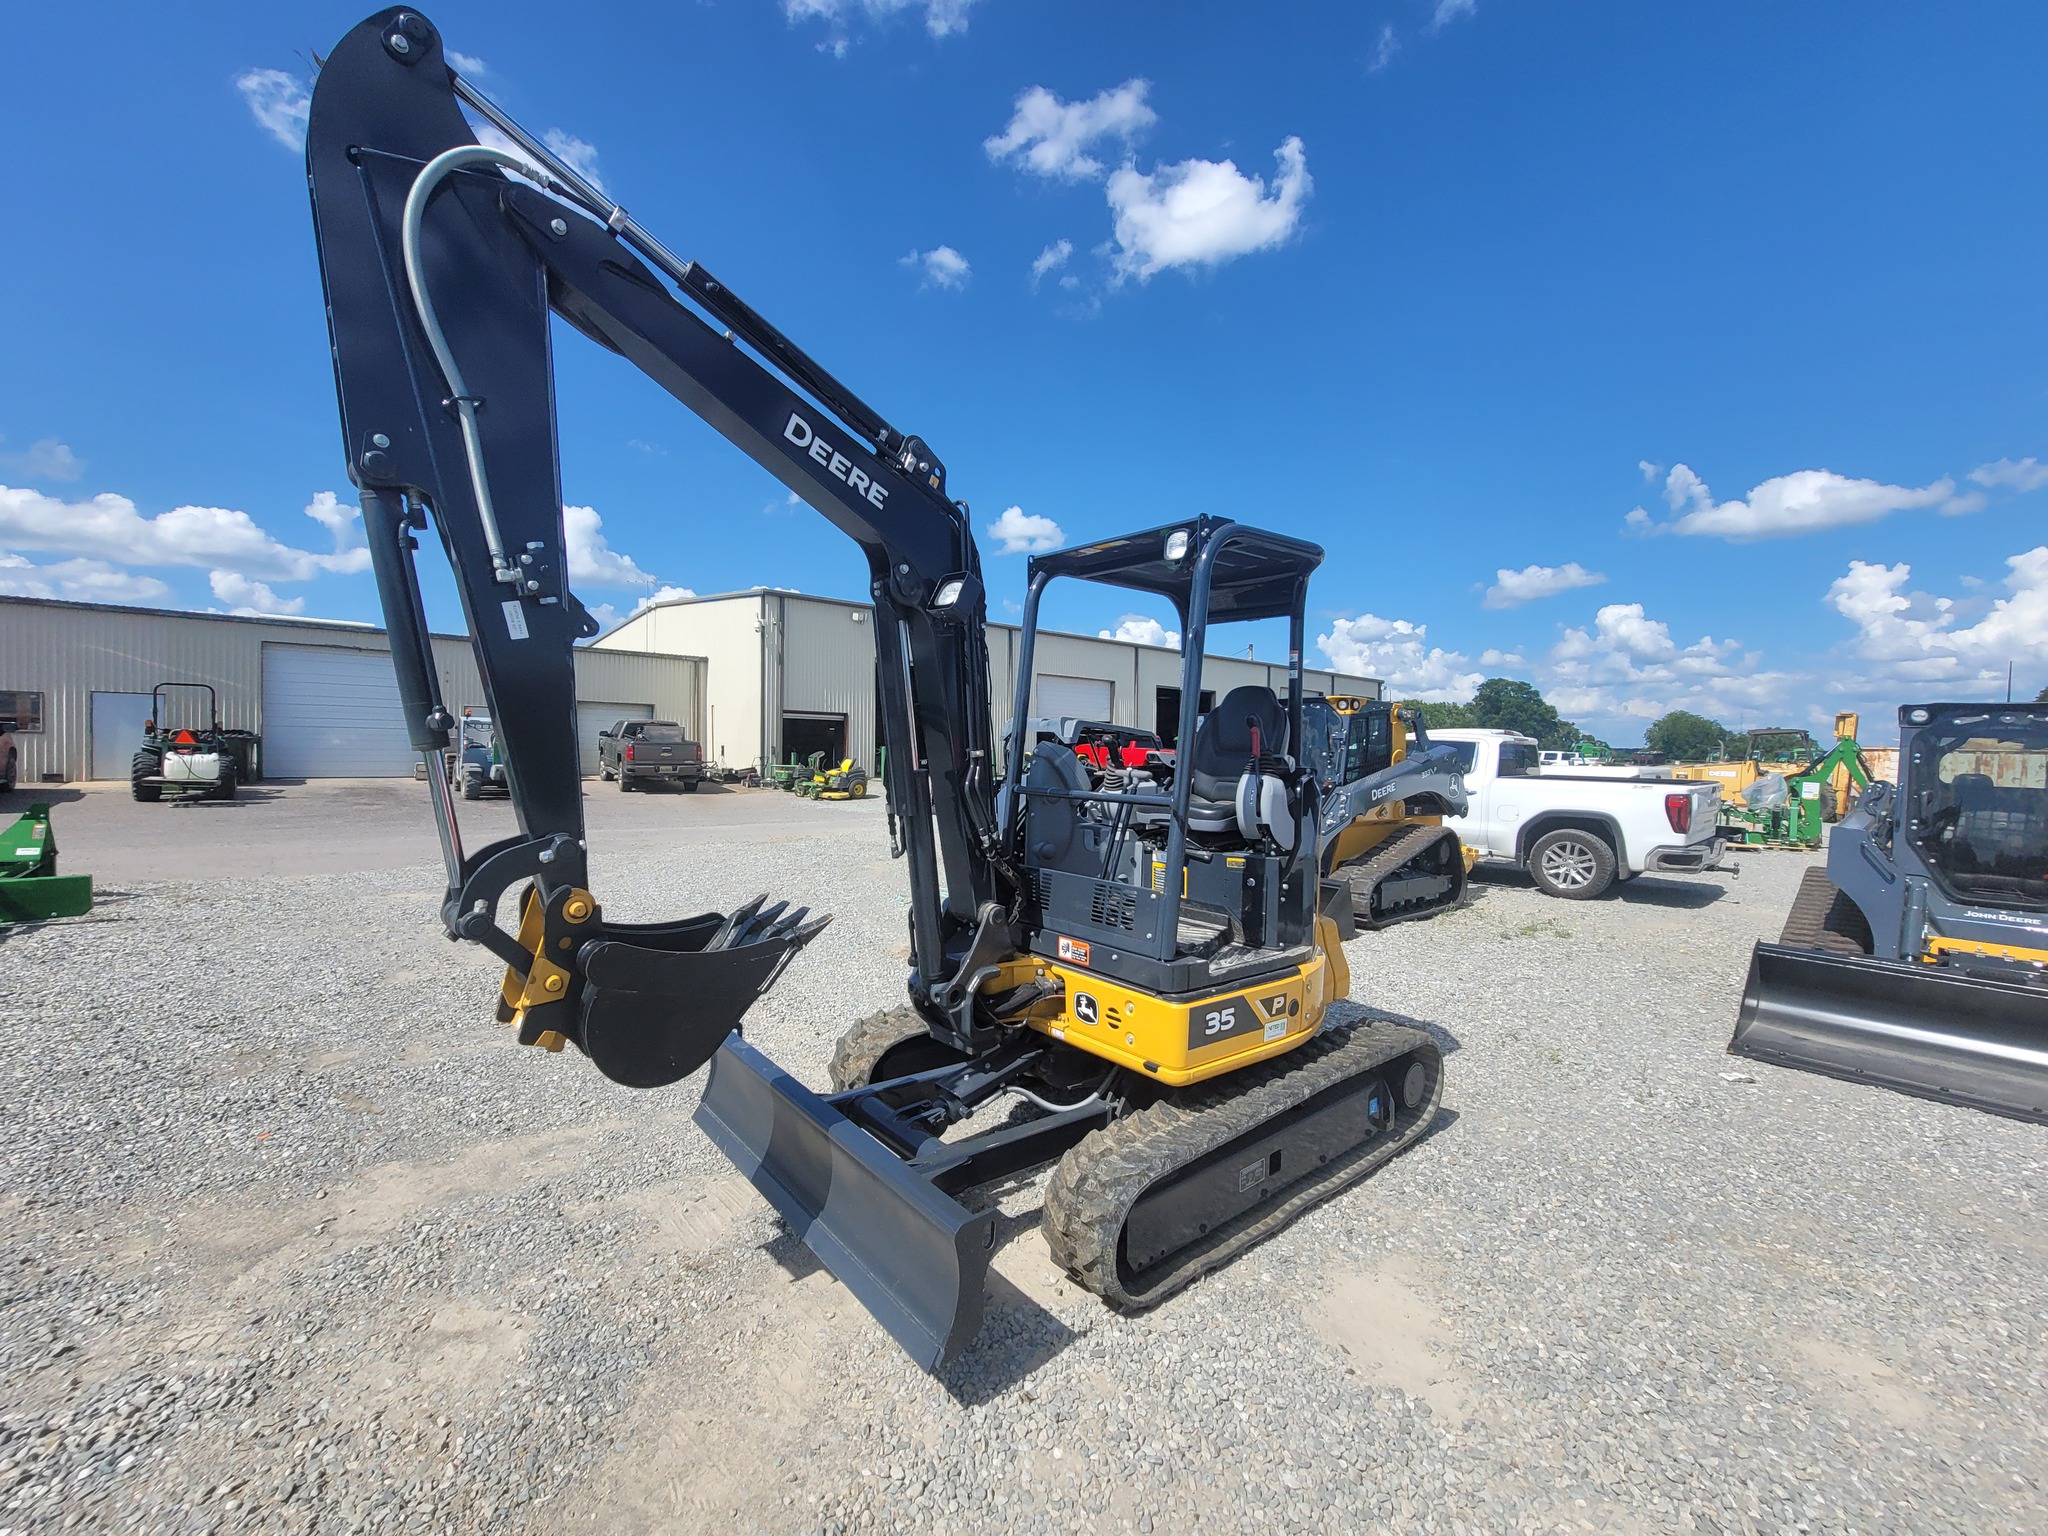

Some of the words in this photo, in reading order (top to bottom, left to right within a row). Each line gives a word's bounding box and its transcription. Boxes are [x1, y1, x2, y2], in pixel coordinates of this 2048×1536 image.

[784, 412, 889, 510] DEERE
[1371, 782, 1397, 801] DEERE
[1963, 910, 1997, 920] JOHN
[1998, 914, 2042, 925] DEERE
[1205, 1007, 1236, 1035] 35
